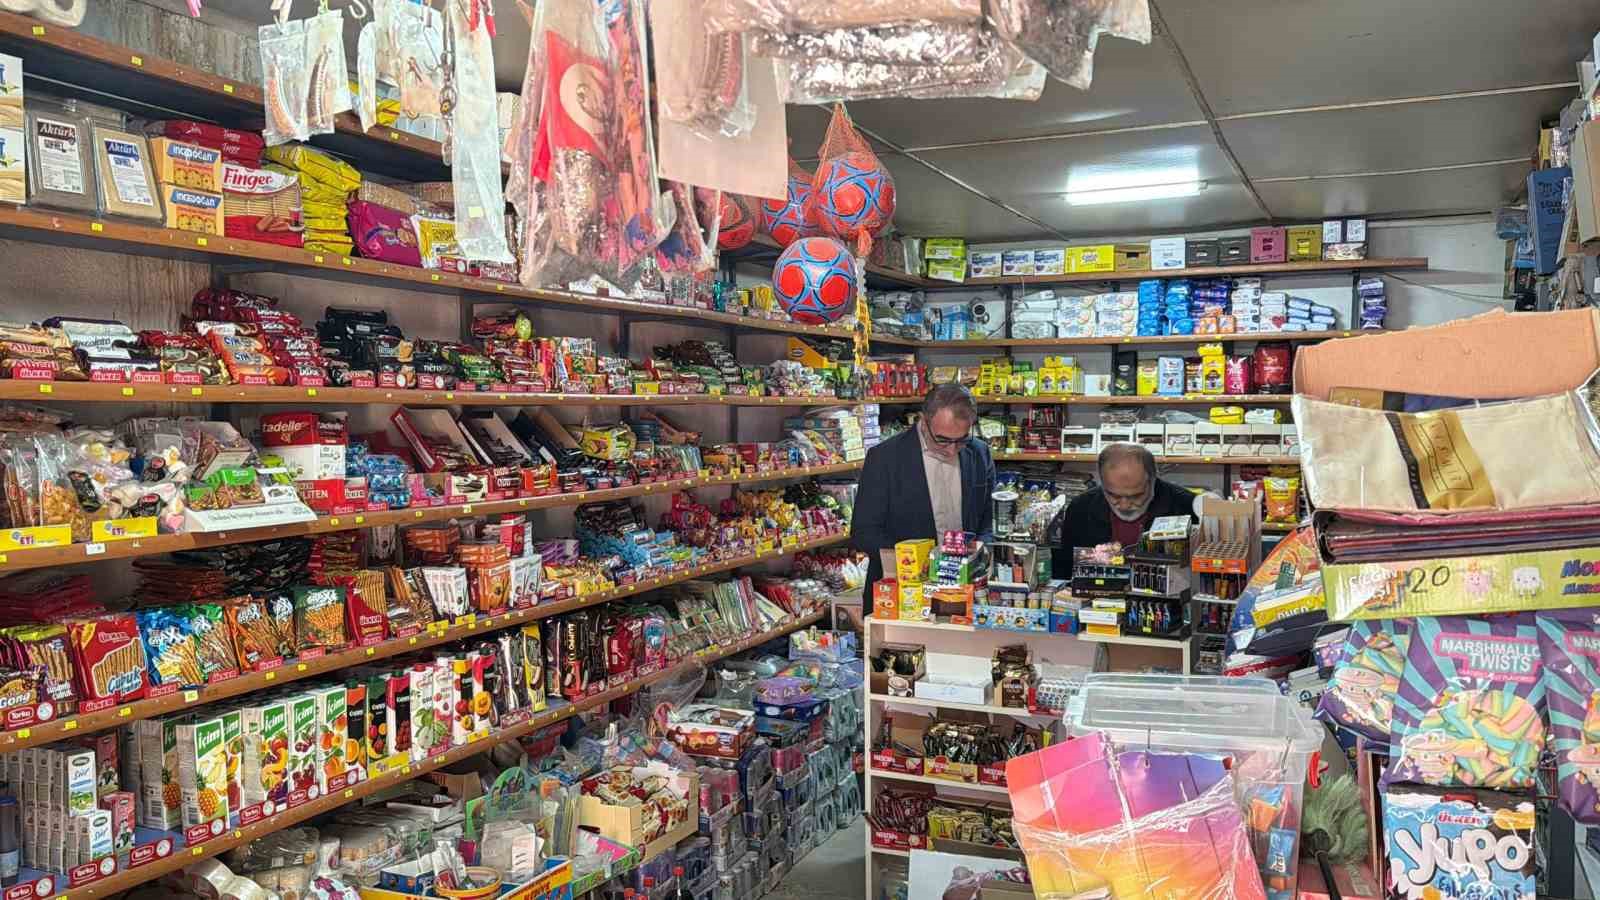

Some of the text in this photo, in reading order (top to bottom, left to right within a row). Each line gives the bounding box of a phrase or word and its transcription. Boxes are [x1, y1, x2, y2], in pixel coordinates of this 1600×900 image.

[39, 122, 76, 139] Aktürk
[223, 167, 272, 189] Finger
[262, 419, 302, 433] tadelle
[1408, 565, 1451, 594] 20
[1441, 639, 1541, 658] MARSHMALLO
[1470, 653, 1531, 673] TWISTS
